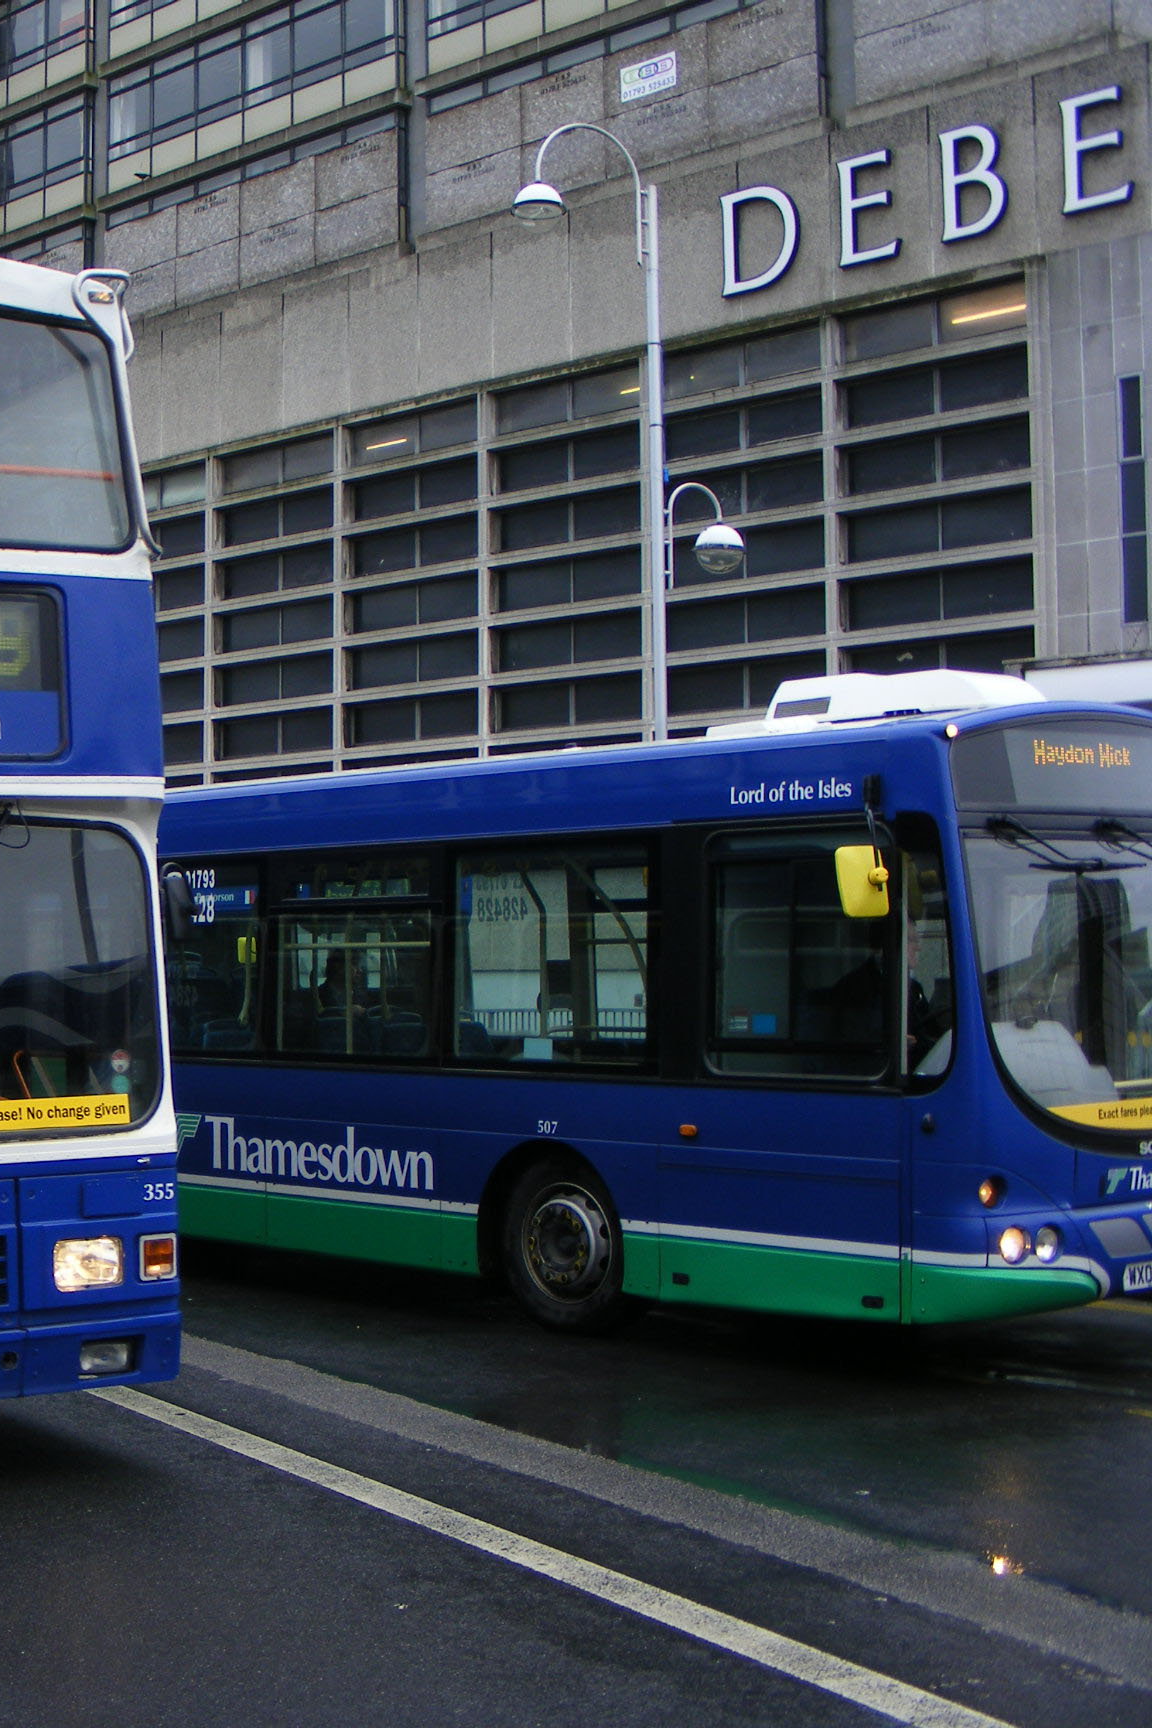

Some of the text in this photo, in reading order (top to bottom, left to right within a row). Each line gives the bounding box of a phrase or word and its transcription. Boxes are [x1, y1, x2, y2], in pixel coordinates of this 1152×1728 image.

[623, 86, 646, 99] 01793
[719, 85, 1135, 299] DEBE
[1033, 739, 1095, 766] Haydon
[730, 777, 852, 805] Lord of the Isles
[26, 1107, 43, 1120] No
[47, 1103, 91, 1120] change
[94, 1101, 126, 1119] given
[1098, 1107, 1119, 1120] Exact
[1120, 1106, 1138, 1118] fares
[537, 1120, 558, 1134] 507
[205, 1115, 434, 1191] Thamesdown
[143, 1183, 175, 1201] 355
